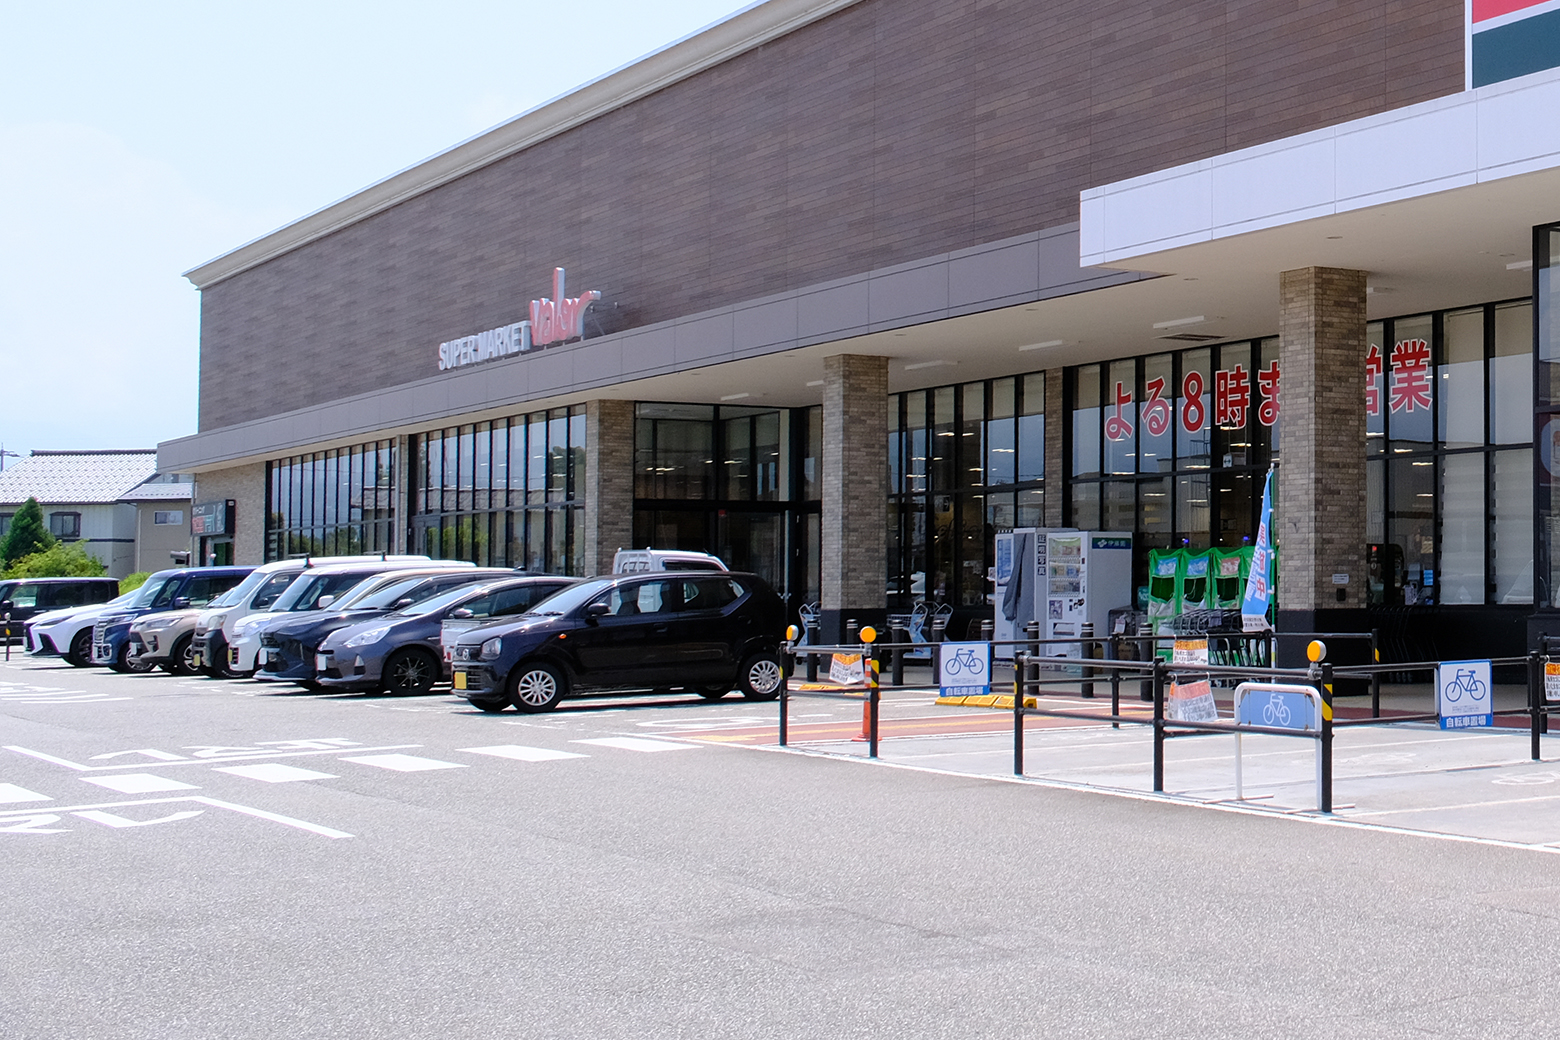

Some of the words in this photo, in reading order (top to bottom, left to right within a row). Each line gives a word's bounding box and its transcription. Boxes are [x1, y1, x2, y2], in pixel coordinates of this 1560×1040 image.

[438, 335, 478, 371] SUPER
[477, 320, 531, 361] MARKET
[1104, 338, 1434, 441] よる8時ま業
[1446, 715, 1487, 728] 自転車置場
